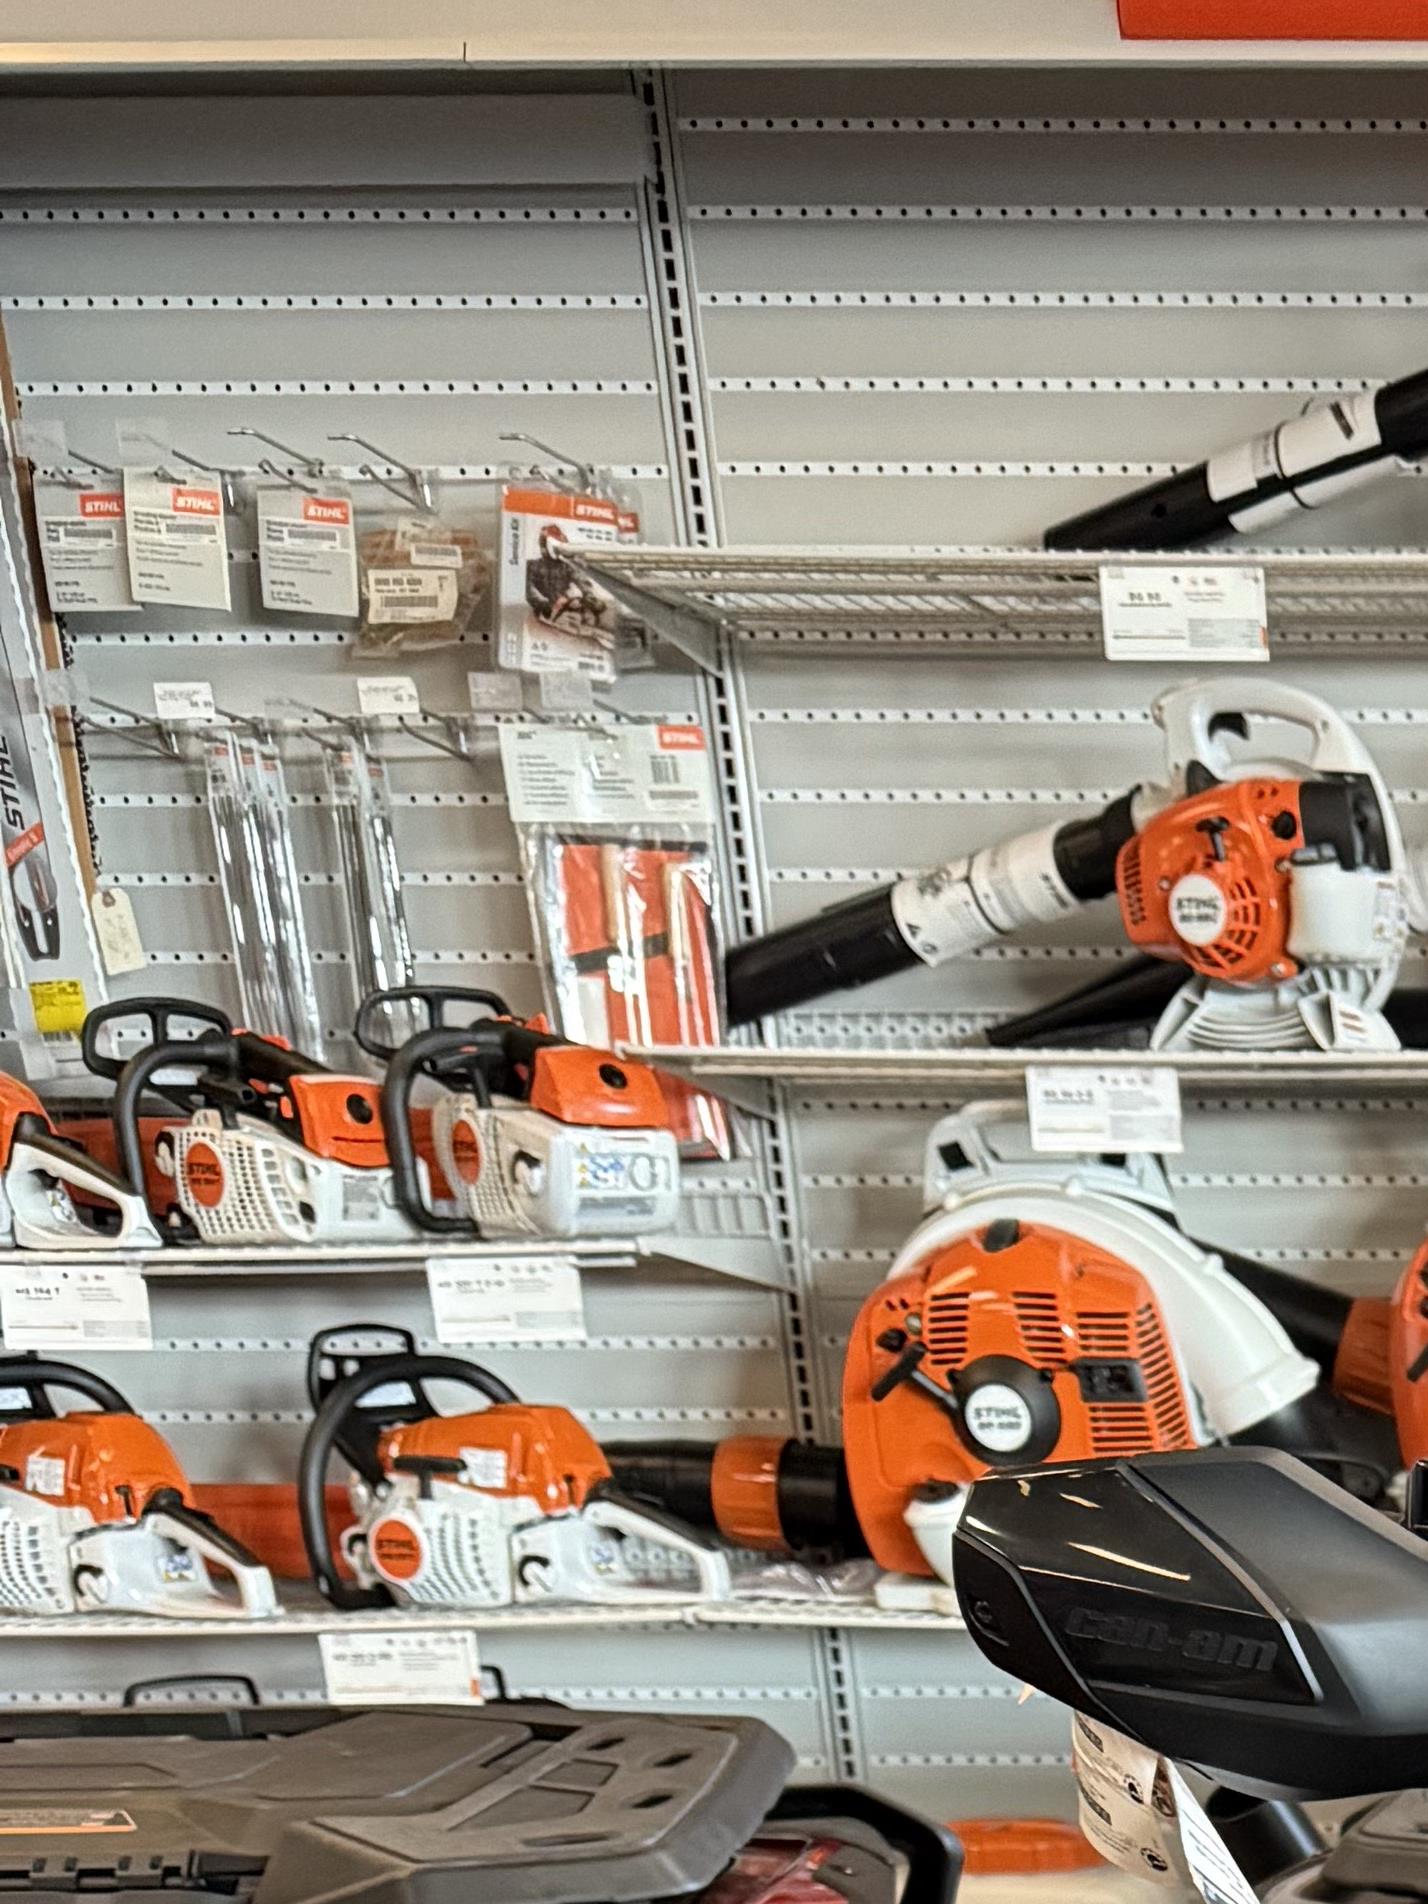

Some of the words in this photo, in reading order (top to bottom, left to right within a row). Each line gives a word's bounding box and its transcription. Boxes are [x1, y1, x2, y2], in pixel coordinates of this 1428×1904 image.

[85, 501, 121, 513] STIHL
[175, 496, 217, 511] STIHL
[307, 506, 347, 519] STIHL
[575, 503, 614, 520] STIHL
[974, 1406, 1021, 1420] STIHL
[1065, 1607, 1279, 1671] can-am
